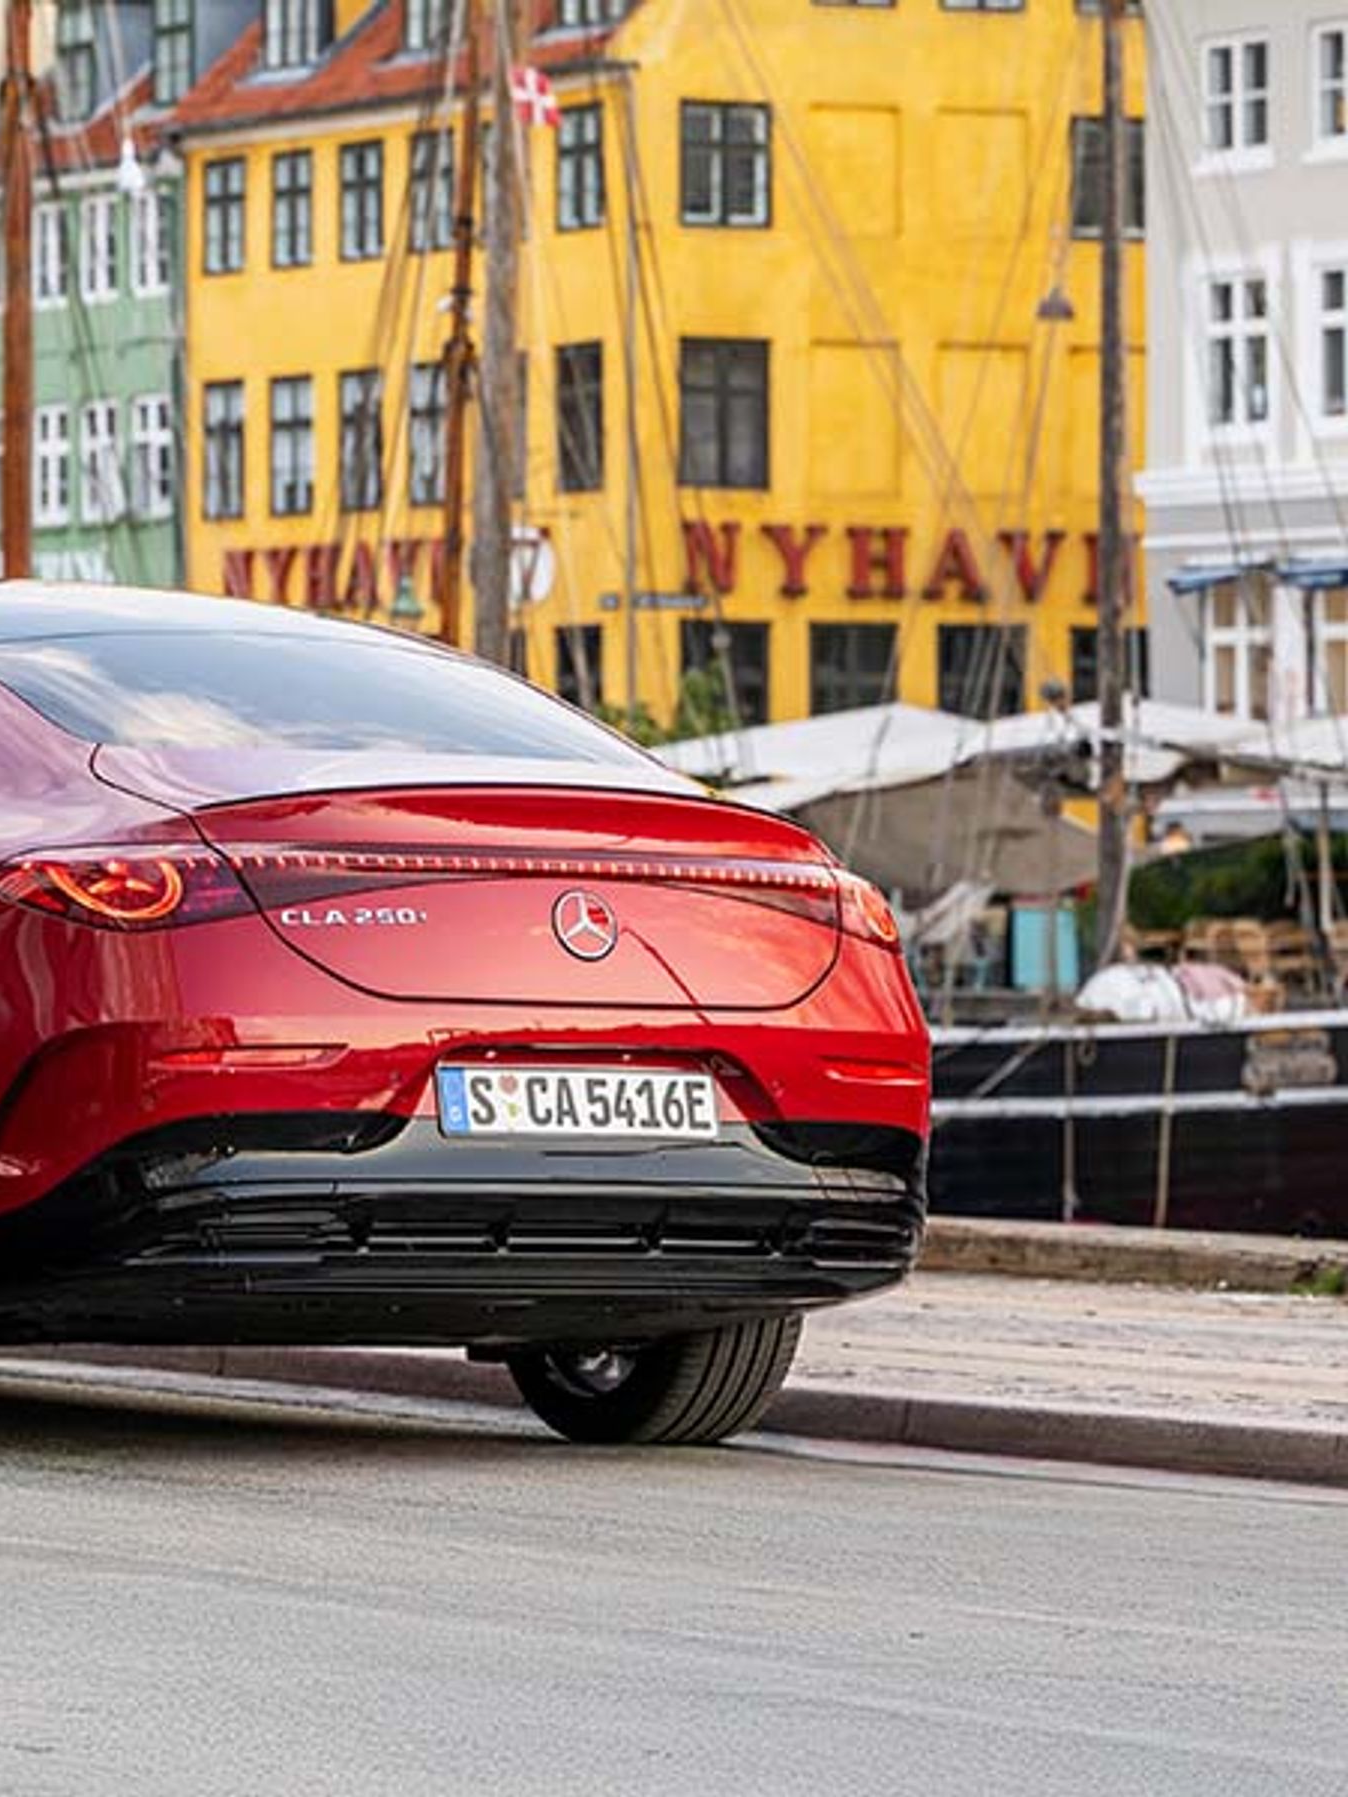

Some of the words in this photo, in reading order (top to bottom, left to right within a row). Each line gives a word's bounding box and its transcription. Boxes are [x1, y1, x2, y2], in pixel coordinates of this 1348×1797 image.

[280, 908, 348, 926] CLA
[469, 1075, 497, 1126] S
[525, 1076, 581, 1128] CA
[585, 1078, 712, 1131] 5416E
